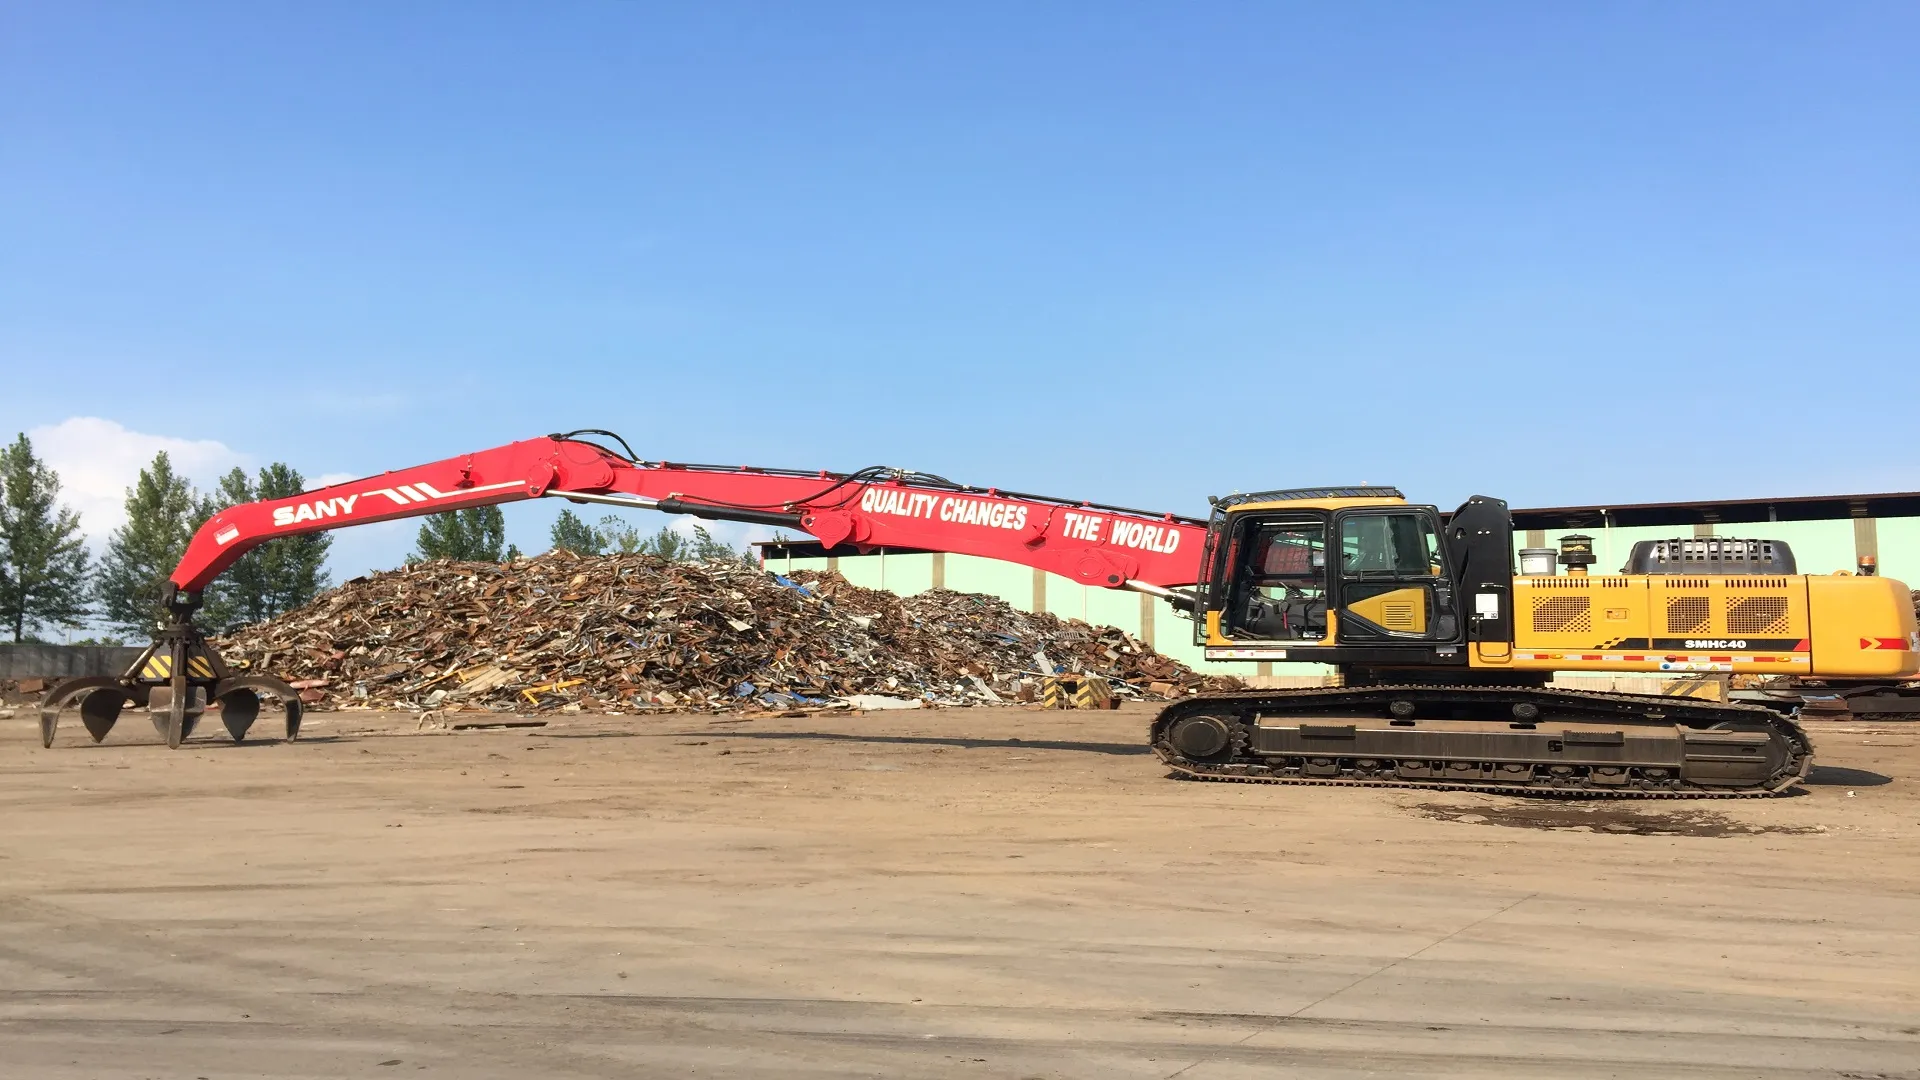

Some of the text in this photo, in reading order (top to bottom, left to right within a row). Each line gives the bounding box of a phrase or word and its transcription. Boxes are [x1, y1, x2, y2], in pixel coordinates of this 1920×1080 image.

[272, 494, 359, 526] SANY
[861, 488, 1180, 554] QUALITY CHANGES THE WORLD
[1684, 640, 1747, 649] SMHC40
